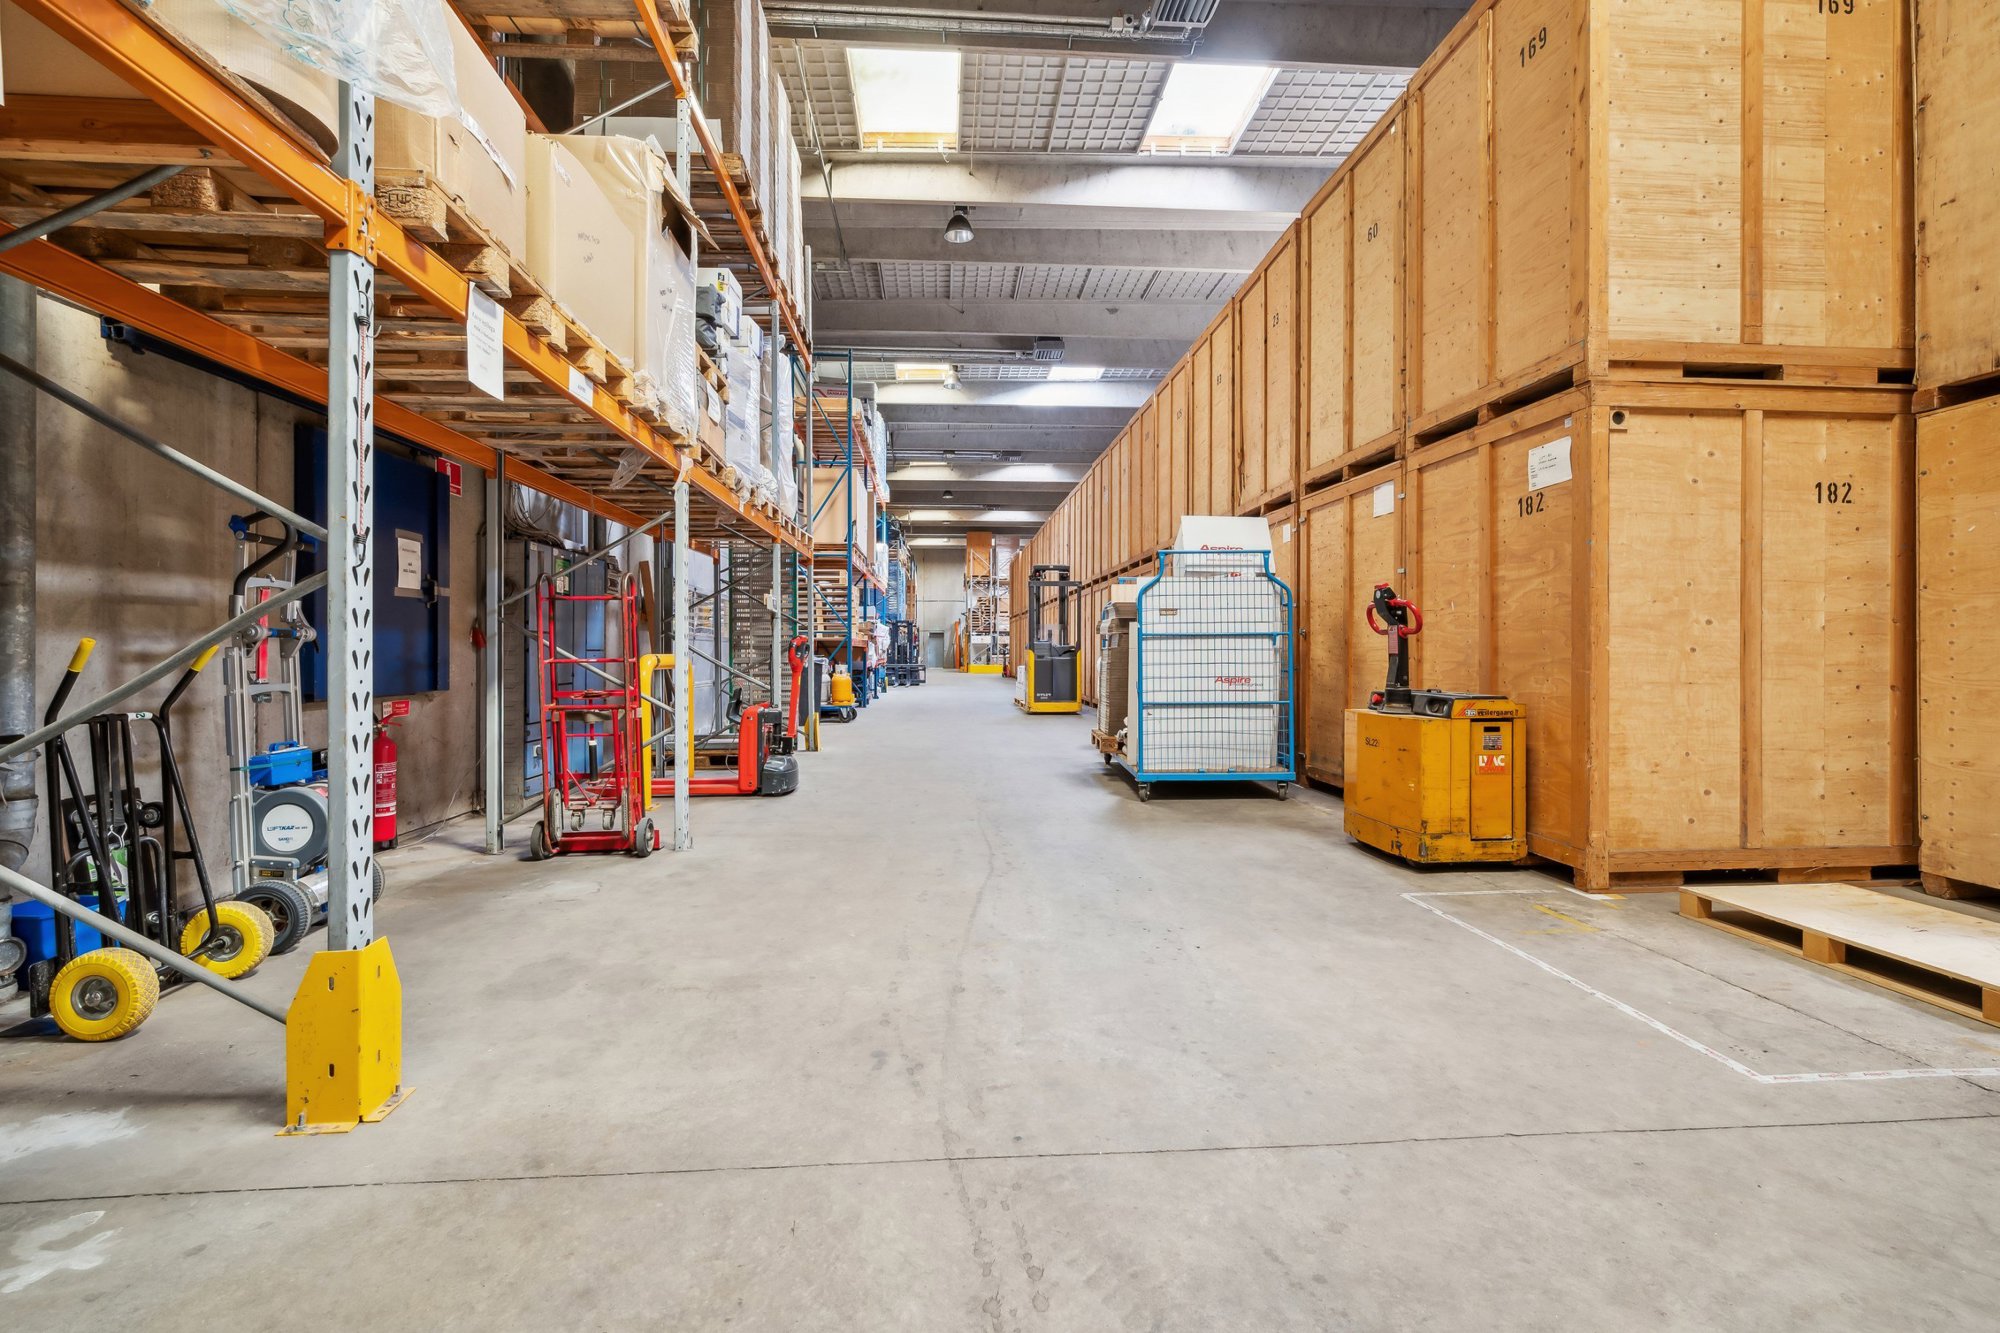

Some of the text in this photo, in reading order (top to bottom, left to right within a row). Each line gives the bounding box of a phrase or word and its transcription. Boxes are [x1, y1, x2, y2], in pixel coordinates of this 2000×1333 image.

[1819, 0, 1854, 14] 169
[1519, 26, 1547, 68] 169
[1367, 222, 1378, 243] 60
[1815, 481, 1852, 504] 182
[1517, 491, 1544, 518] 182
[1214, 675, 1252, 687] Aspire
